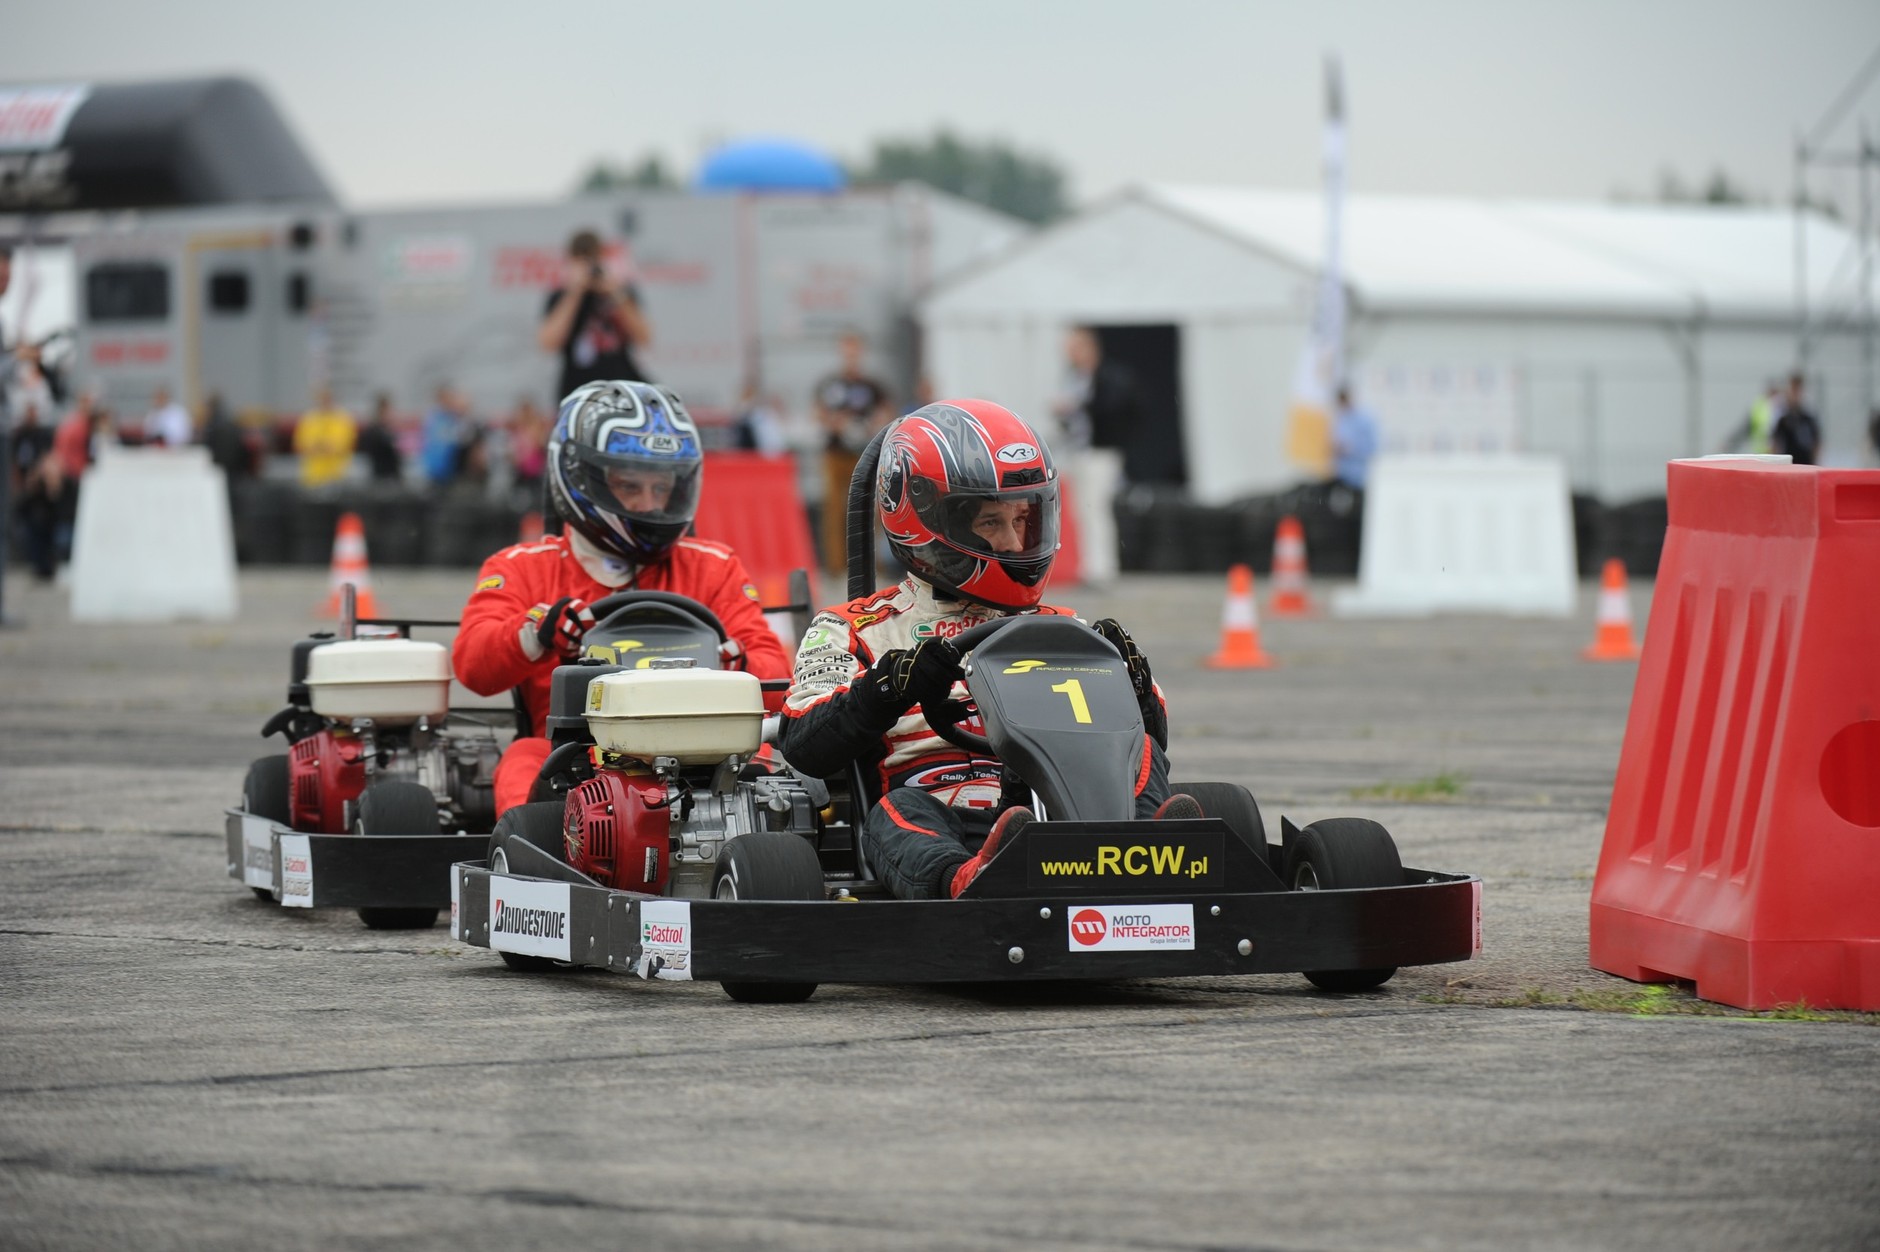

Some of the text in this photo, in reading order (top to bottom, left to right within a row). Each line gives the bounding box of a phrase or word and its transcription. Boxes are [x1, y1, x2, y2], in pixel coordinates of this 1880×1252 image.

[1002, 447, 1035, 459] VR-1
[799, 642, 833, 659] Q-SERVICE
[1051, 678, 1093, 724] 1
[940, 774, 967, 782] Rally
[973, 771, 998, 781] Team
[1041, 845, 1209, 879] www.RCW.pl
[493, 899, 566, 940] BRIDGESTONE
[1112, 915, 1151, 927] MOTO
[651, 925, 684, 944] Castrol
[1112, 926, 1190, 938] INTEGRATOR
